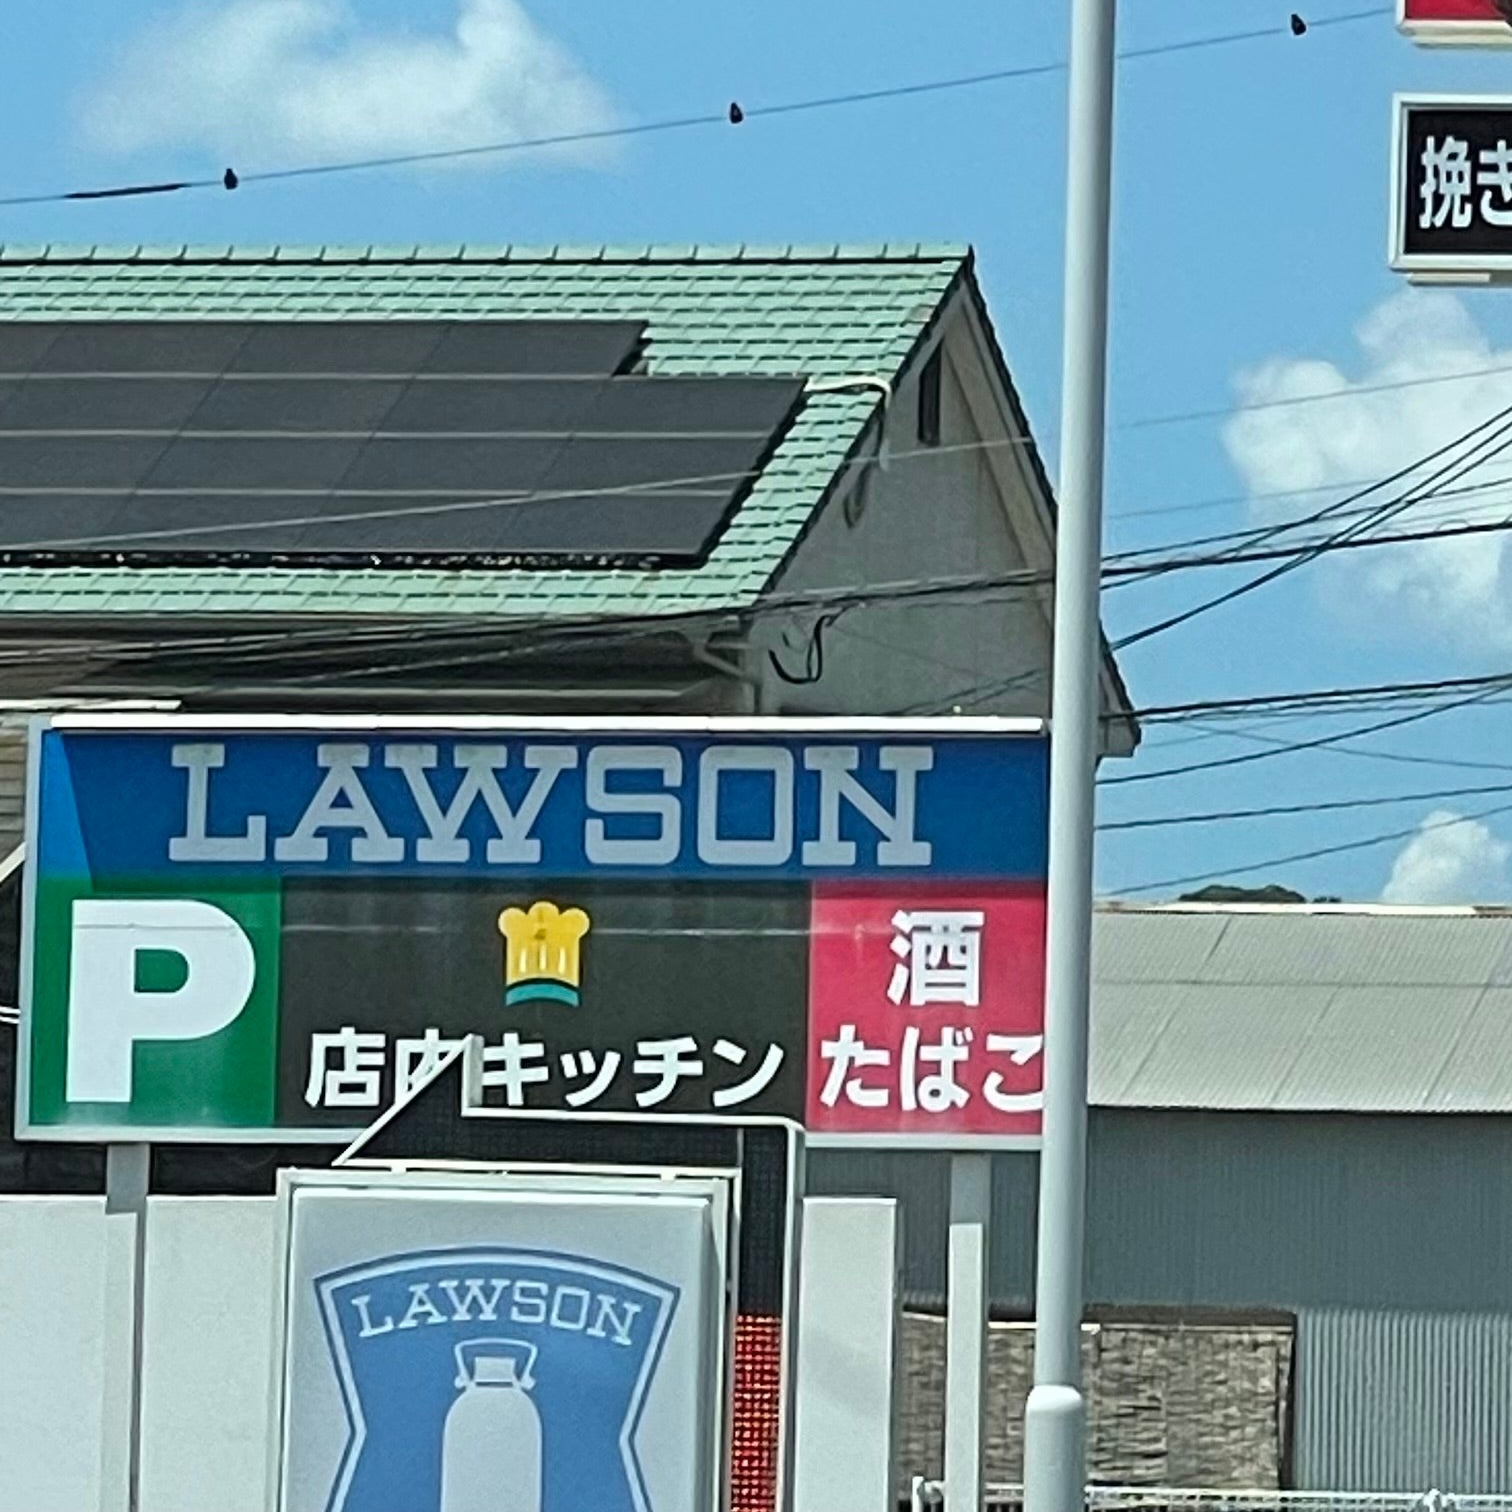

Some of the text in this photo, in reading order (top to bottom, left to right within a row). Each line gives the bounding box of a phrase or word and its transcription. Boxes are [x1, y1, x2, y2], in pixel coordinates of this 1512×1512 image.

[169, 744, 934, 866] LAWSON
[66, 899, 256, 1103] P
[886, 909, 985, 1007] 酒
[820, 1024, 1044, 1114] たばこ
[350, 1277, 643, 1347] LAWSON
